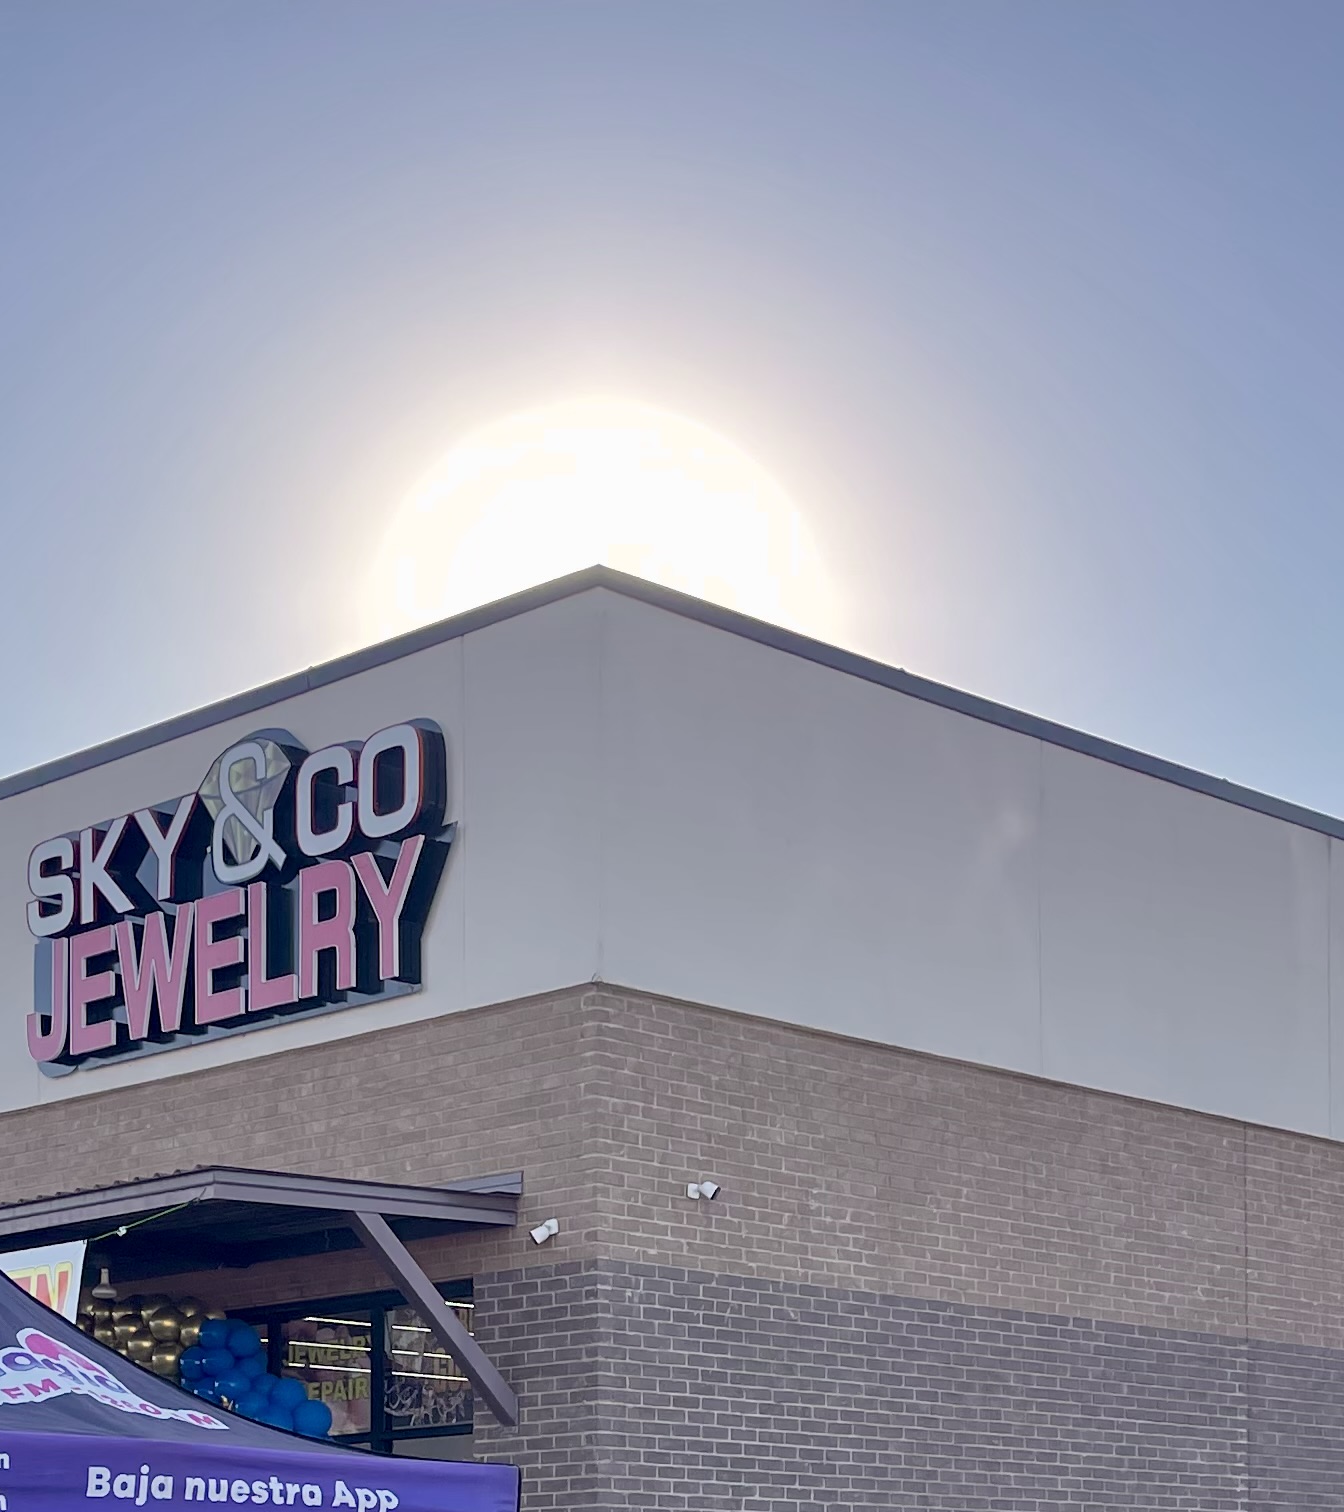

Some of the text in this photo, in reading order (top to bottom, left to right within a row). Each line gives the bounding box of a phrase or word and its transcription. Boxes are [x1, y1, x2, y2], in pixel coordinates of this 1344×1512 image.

[27, 834, 426, 1062] JEWELRY
[1, 1378, 61, 1401] FM
[308, 1377, 369, 1401] EPAIR
[85, 1464, 174, 1507] Baja
[184, 1475, 323, 1507] nuestra
